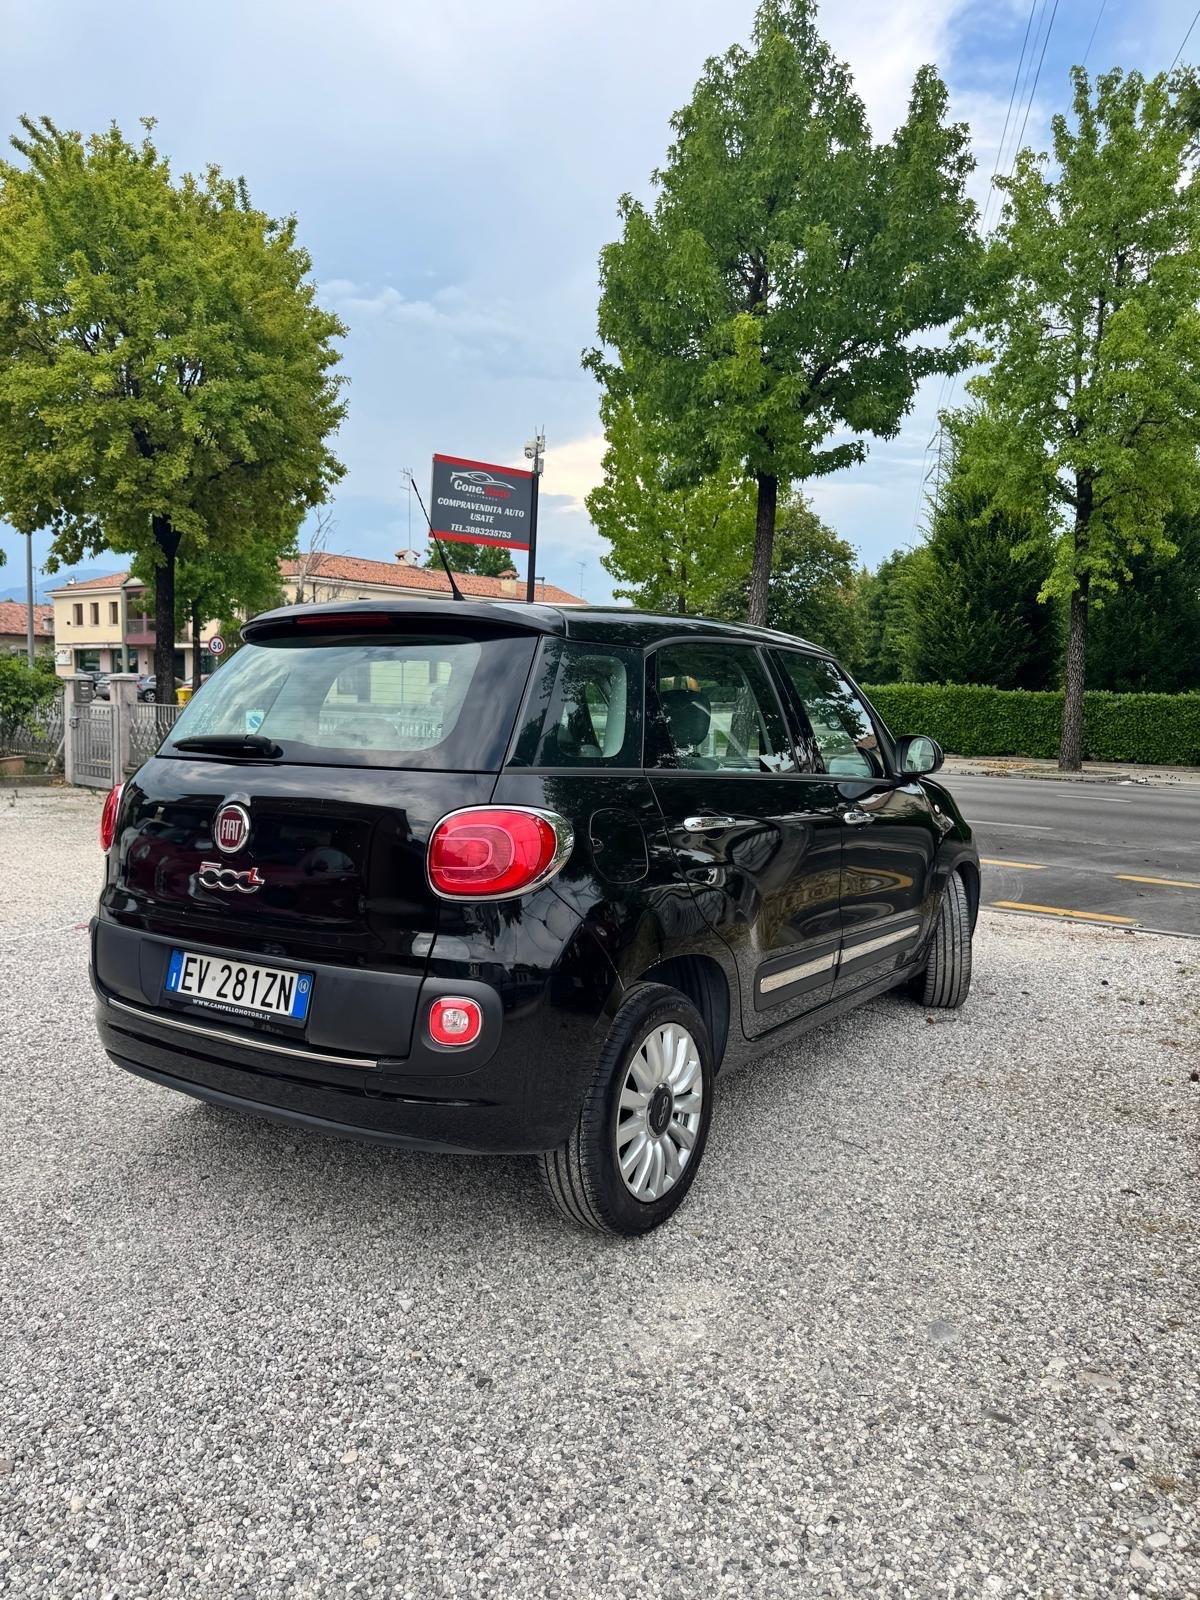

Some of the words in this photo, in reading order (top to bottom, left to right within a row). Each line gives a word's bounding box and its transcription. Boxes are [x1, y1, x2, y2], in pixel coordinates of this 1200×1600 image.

[437, 497, 502, 514] COMPRAVENDITA
[504, 508, 525, 518] AUTO
[470, 513, 495, 523] USATE
[212, 642, 221, 650] 50
[221, 819, 241, 840] FIAT
[181, 957, 211, 993] EV
[216, 964, 294, 1012] 281ZN
[192, 998, 271, 1020] WWW.CAMPELLOMOTORS.IT
